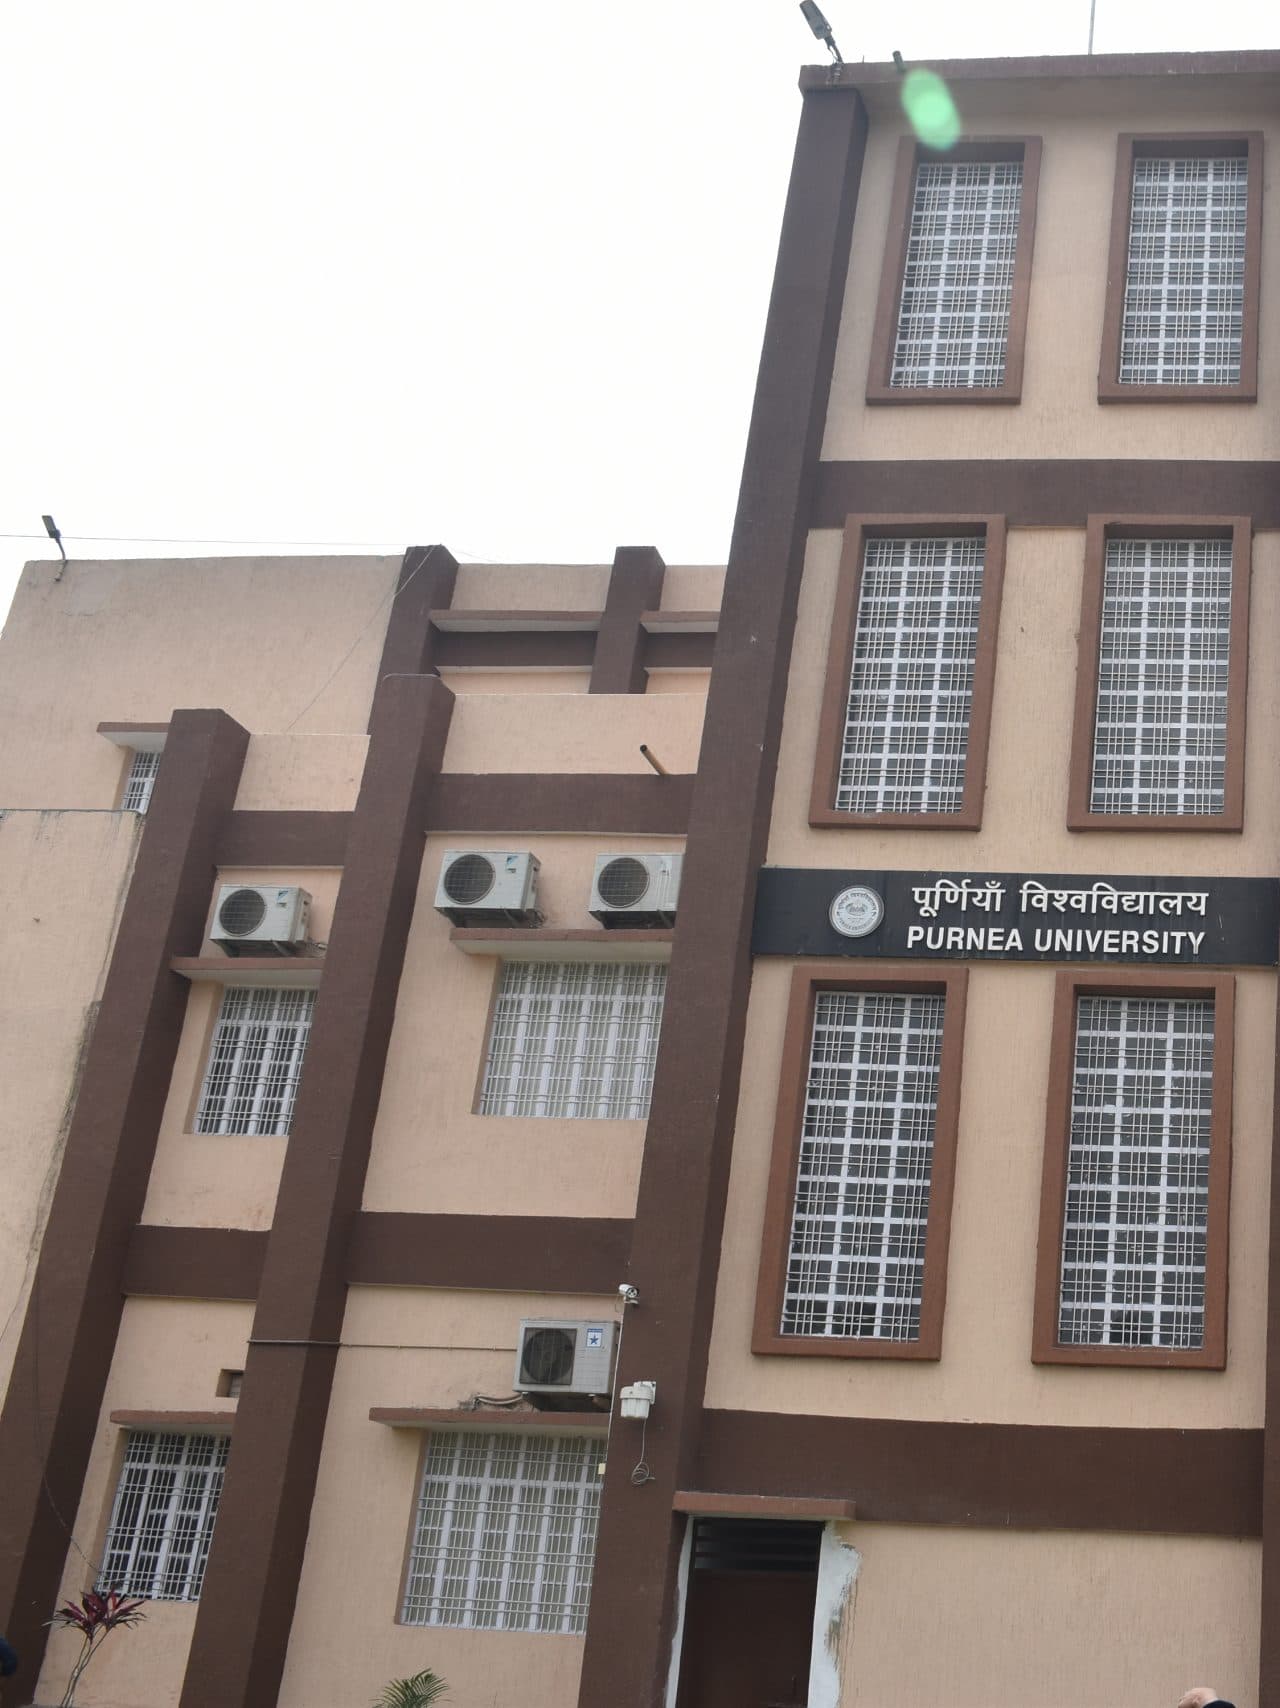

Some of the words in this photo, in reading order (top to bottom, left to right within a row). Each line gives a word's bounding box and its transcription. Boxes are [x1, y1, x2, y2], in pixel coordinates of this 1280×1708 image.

[912, 879, 1006, 917] पूर्णियाँ
[1019, 881, 1209, 916] विश्वविद्यालय
[907, 926, 1023, 951] PURNEA
[1034, 928, 1206, 955] UNIVERSITY
